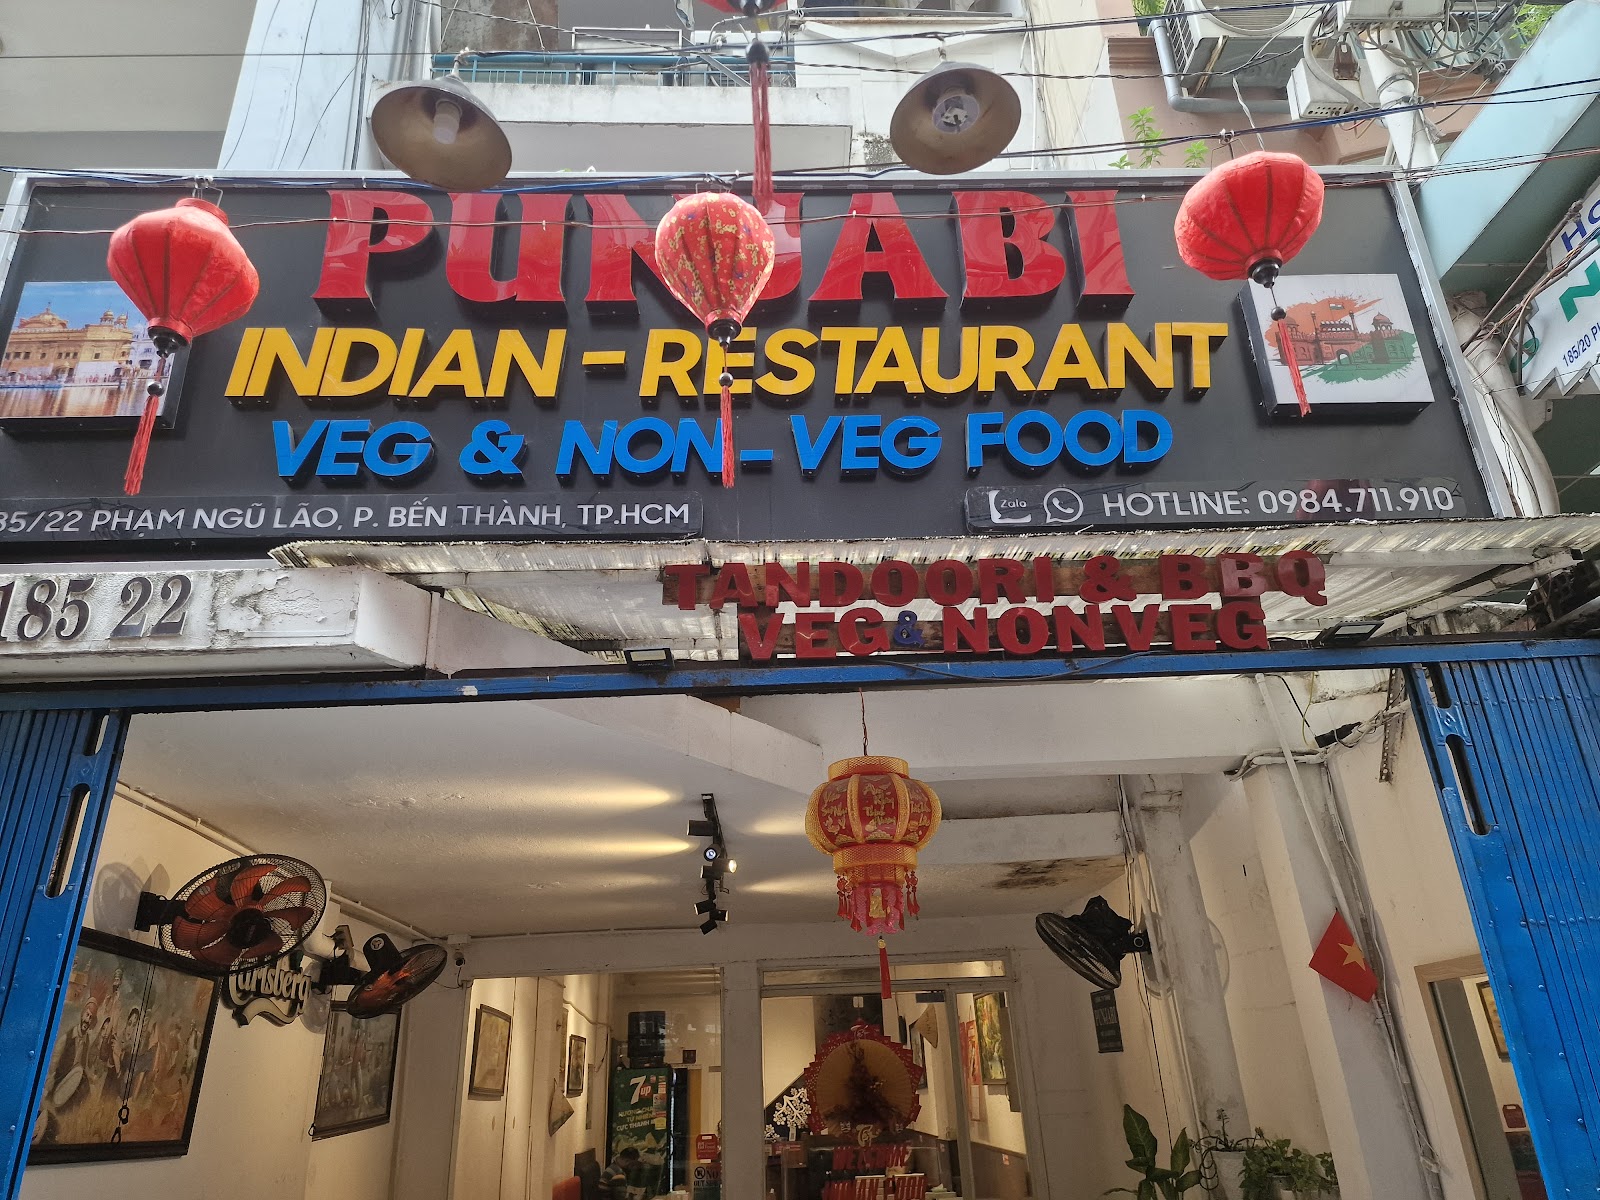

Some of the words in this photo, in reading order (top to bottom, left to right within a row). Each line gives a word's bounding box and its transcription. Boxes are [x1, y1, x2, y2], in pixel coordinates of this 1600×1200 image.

[224, 327, 567, 398] INDIAN
[639, 323, 1228, 396] RESTAURANT
[1562, 334, 1591, 367] 185/20
[272, 419, 434, 477] VEG
[459, 419, 526, 476] &
[790, 414, 942, 470] VEG
[966, 409, 1173, 467] FOOD
[91, 508, 185, 537] PHẠM
[193, 502, 266, 529] NGŨ
[273, 502, 342, 531] LÃO,
[353, 506, 379, 527] P.
[388, 497, 447, 527] BẾN
[457, 499, 567, 528] THÀNH,
[577, 503, 689, 525] TP.HCM
[1000, 498, 1027, 508] Zalo
[1102, 489, 1250, 517] HOTLINE:
[1257, 486, 1454, 515] 0984.711.910
[664, 555, 1056, 610] TANDOORI
[1079, 554, 1137, 604] &
[110, 574, 193, 639] 22
[738, 606, 891, 660] VEG
[893, 610, 924, 647] &
[942, 601, 1270, 656] NONVEG
[629, 1075, 651, 1105] 7up
